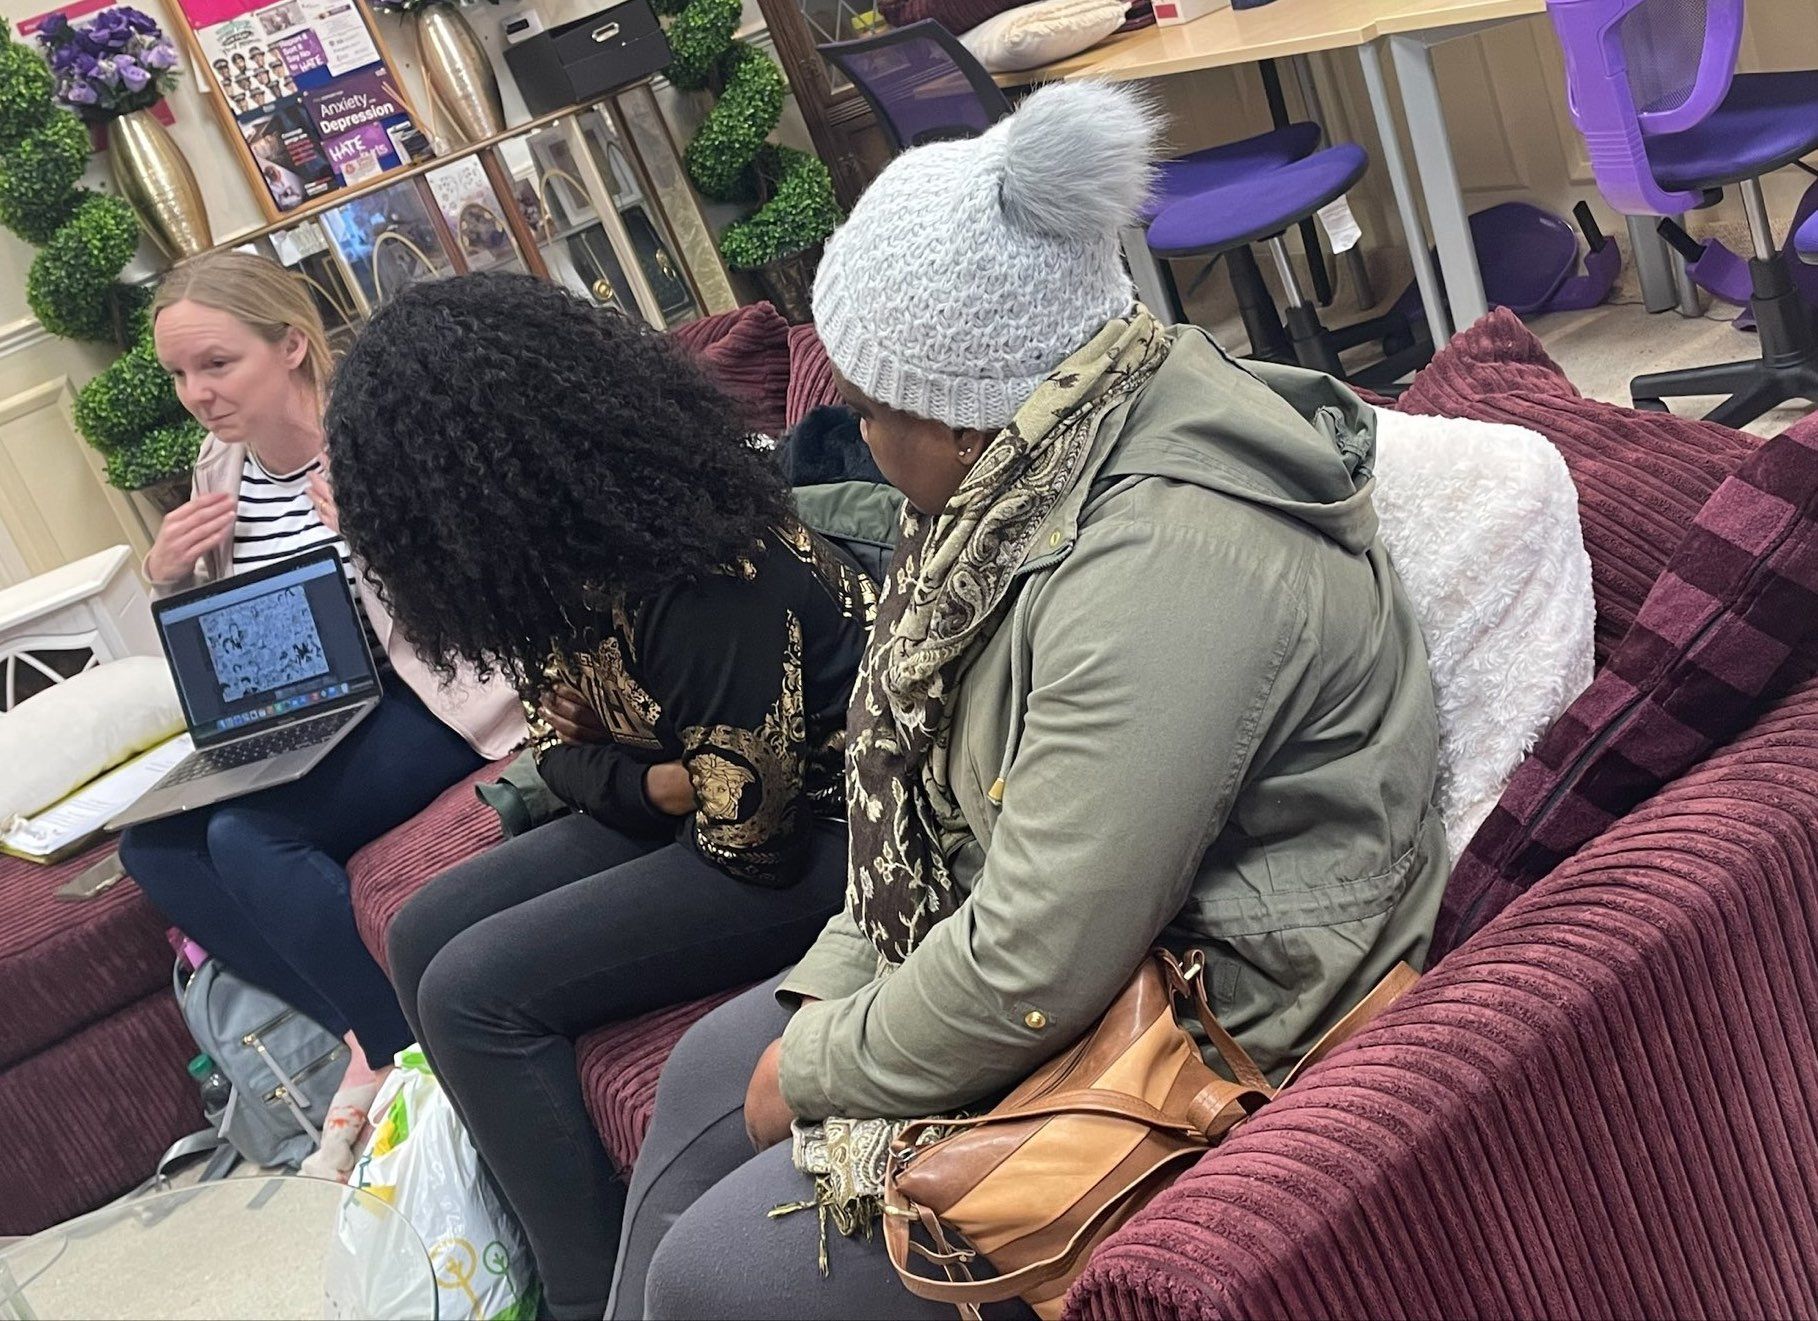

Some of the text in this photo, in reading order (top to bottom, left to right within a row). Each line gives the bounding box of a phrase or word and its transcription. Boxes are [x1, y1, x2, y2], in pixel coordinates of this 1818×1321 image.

[299, 54, 324, 72] HATE
[319, 102, 395, 135] Depression
[320, 93, 368, 118] Anxiety
[328, 134, 367, 162] HATE
